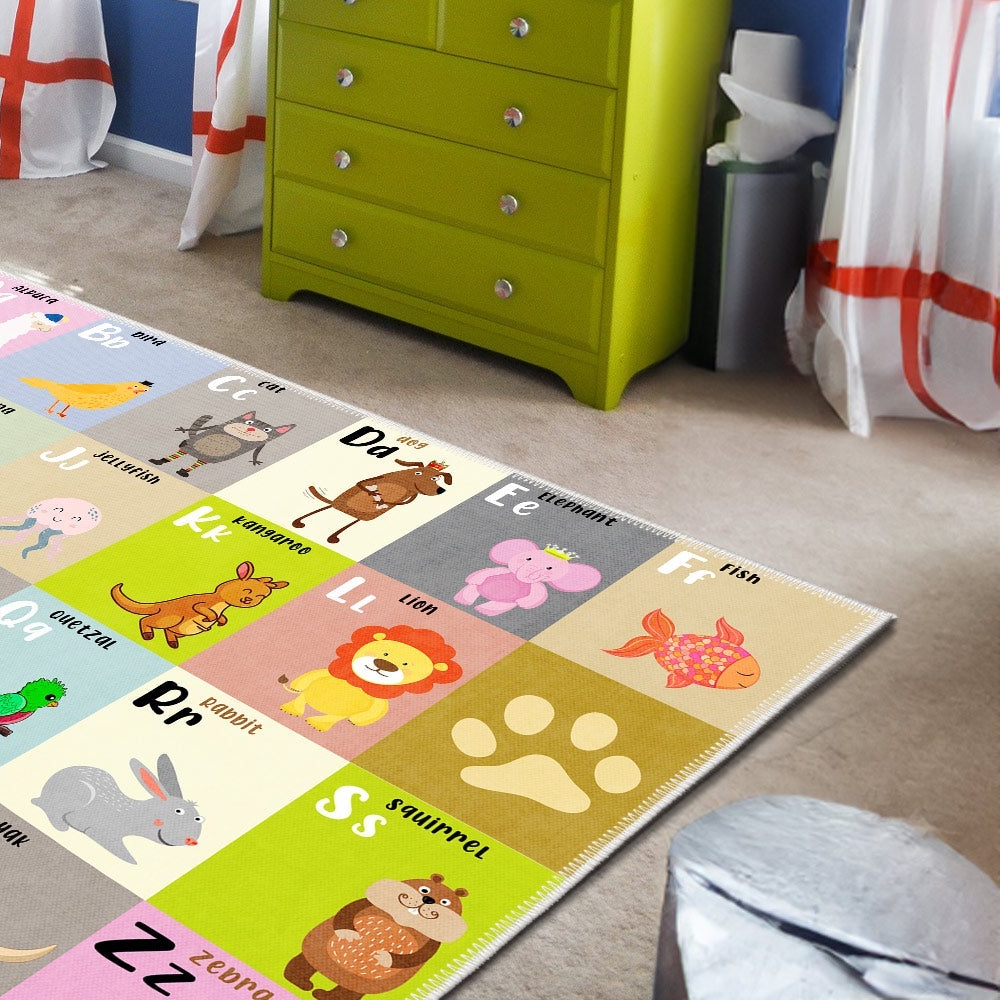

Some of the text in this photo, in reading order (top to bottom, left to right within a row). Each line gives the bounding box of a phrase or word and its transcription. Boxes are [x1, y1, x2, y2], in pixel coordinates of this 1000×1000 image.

[207, 375, 258, 401] Cc
[39, 446, 89, 471] Jj
[339, 425, 400, 459] Dd
[484, 482, 540, 516] Ee
[172, 505, 232, 544] Kk
[657, 550, 716, 585] Ff
[132, 680, 203, 727] Rr
[315, 785, 387, 838] Ss
[94, 921, 196, 997] Zz
